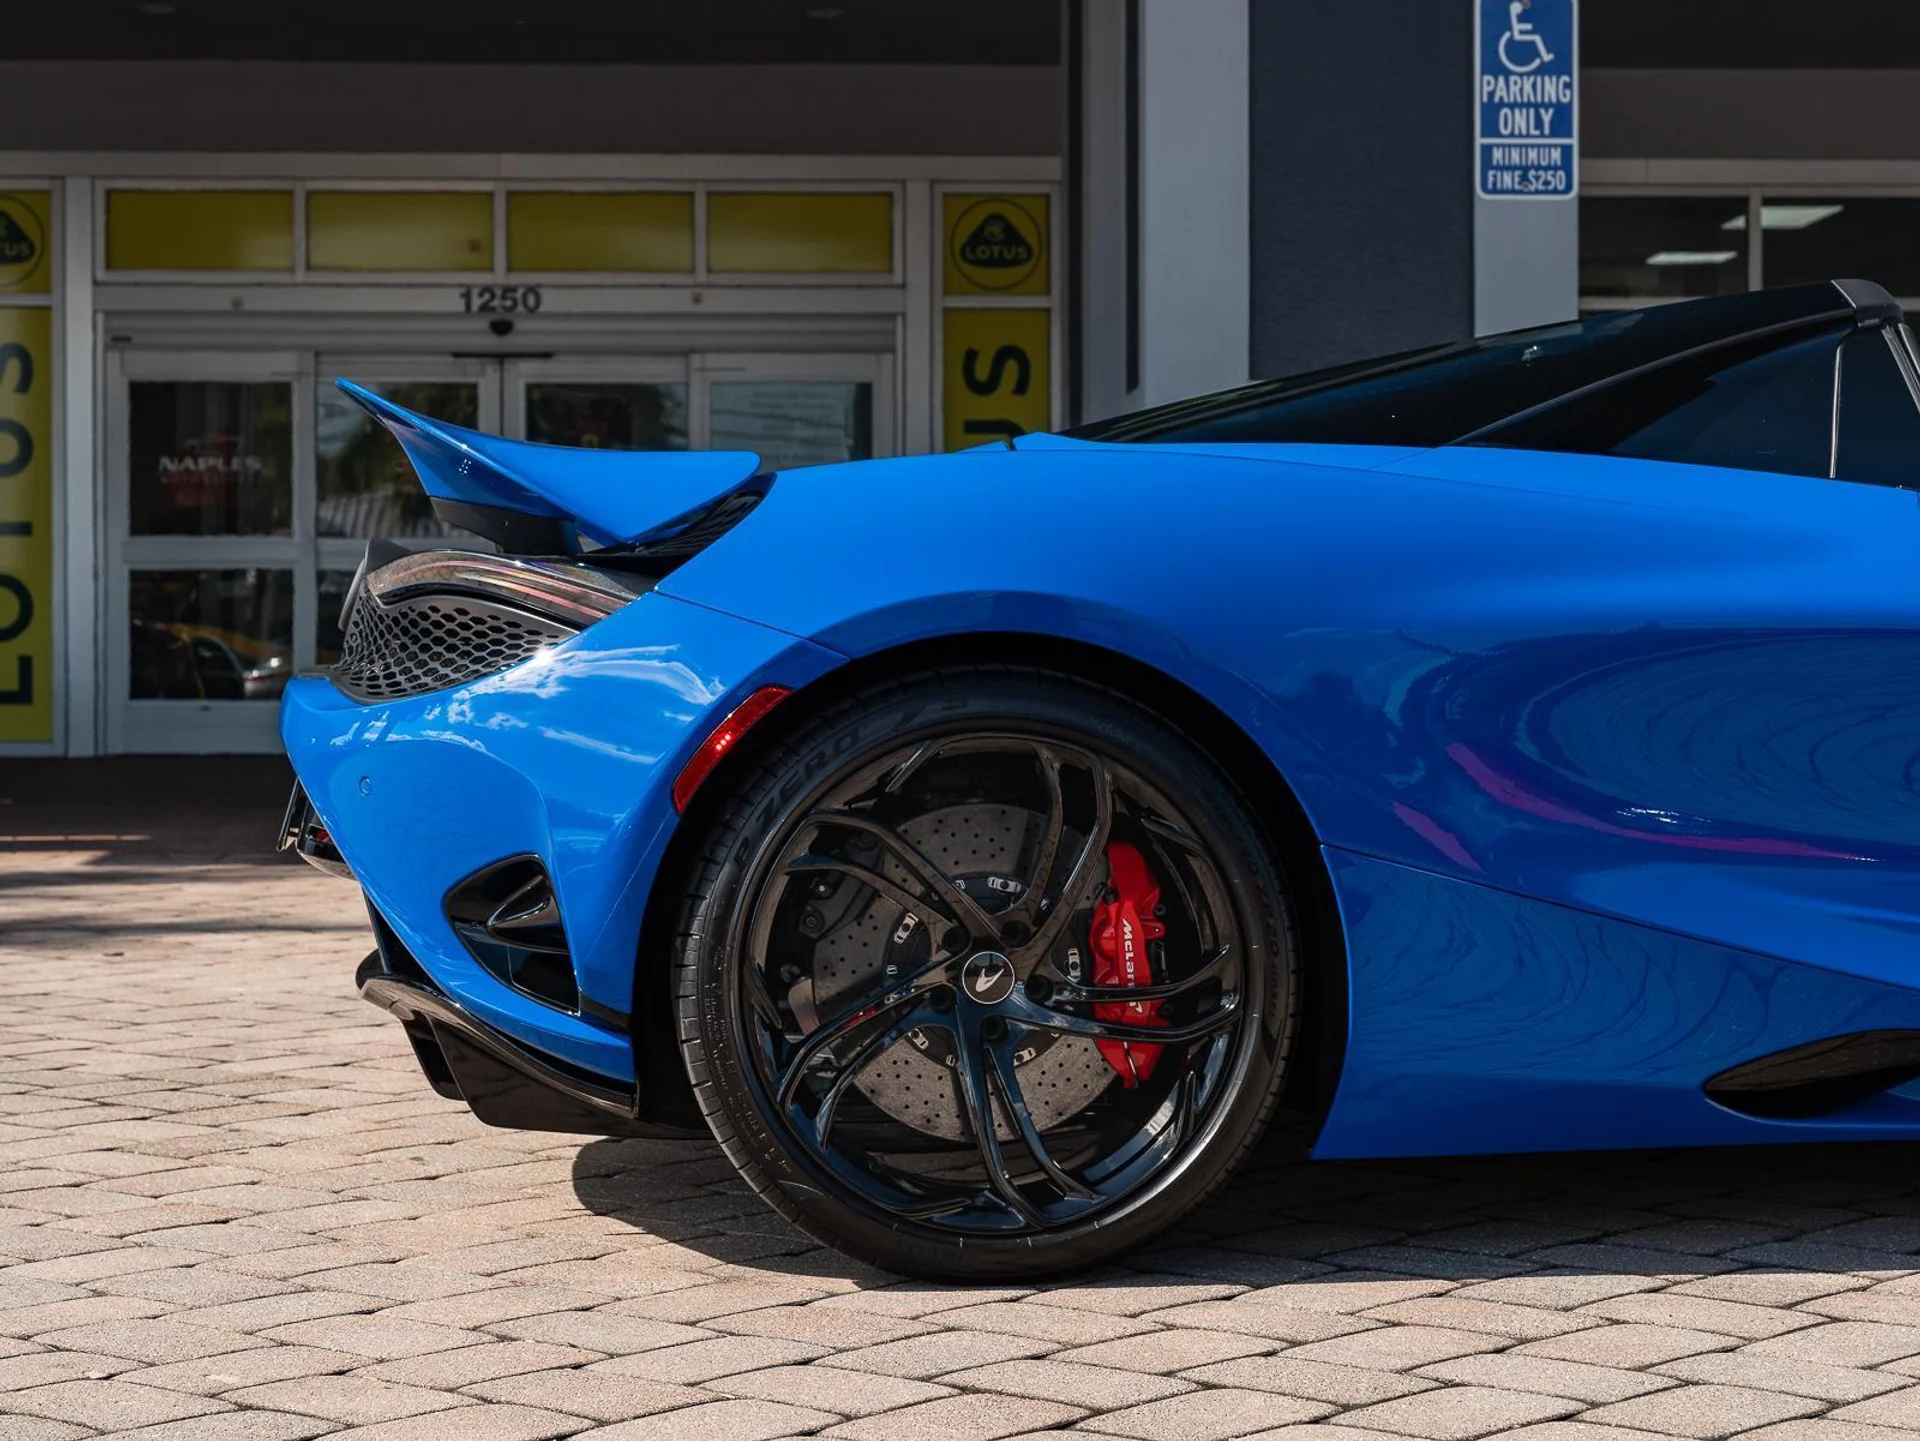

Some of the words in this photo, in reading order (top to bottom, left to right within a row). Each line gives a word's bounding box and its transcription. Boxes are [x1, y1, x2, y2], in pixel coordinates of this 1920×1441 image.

[1482, 74, 1571, 104] PARKING
[1499, 107, 1554, 136] ONLY
[1492, 146, 1562, 167] MINIMUM
[1487, 169, 1523, 191] FINE
[1527, 168, 1566, 192] $250
[964, 244, 1030, 260] LOTUS
[459, 285, 542, 314] 1250
[158, 455, 263, 472] NAPLES
[0, 342, 34, 706] LOUS
[756, 727, 860, 829] ZERO
